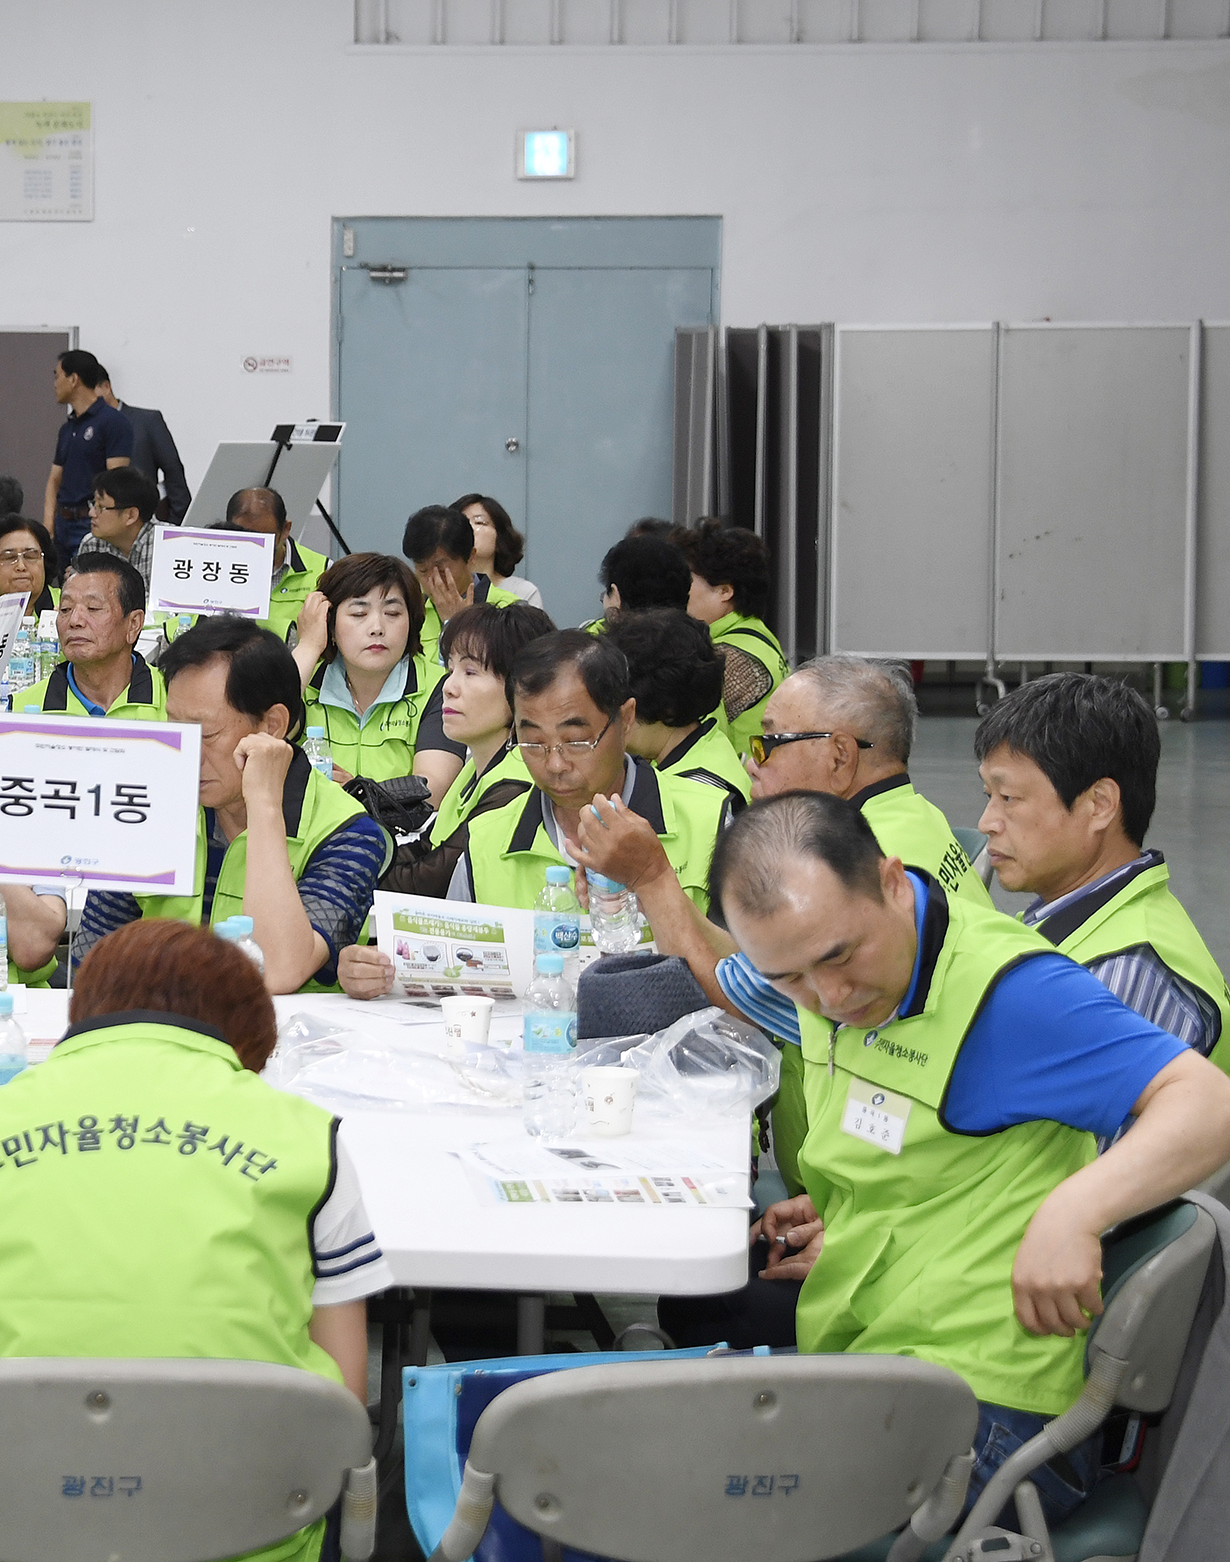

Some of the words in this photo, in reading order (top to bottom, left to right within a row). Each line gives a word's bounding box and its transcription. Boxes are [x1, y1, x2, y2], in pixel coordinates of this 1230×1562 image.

[172, 559, 250, 585] 광장동
[555, 930, 578, 941] 백산수
[62, 1475, 142, 1498] 광진구
[725, 1473, 800, 1497] 광진구
